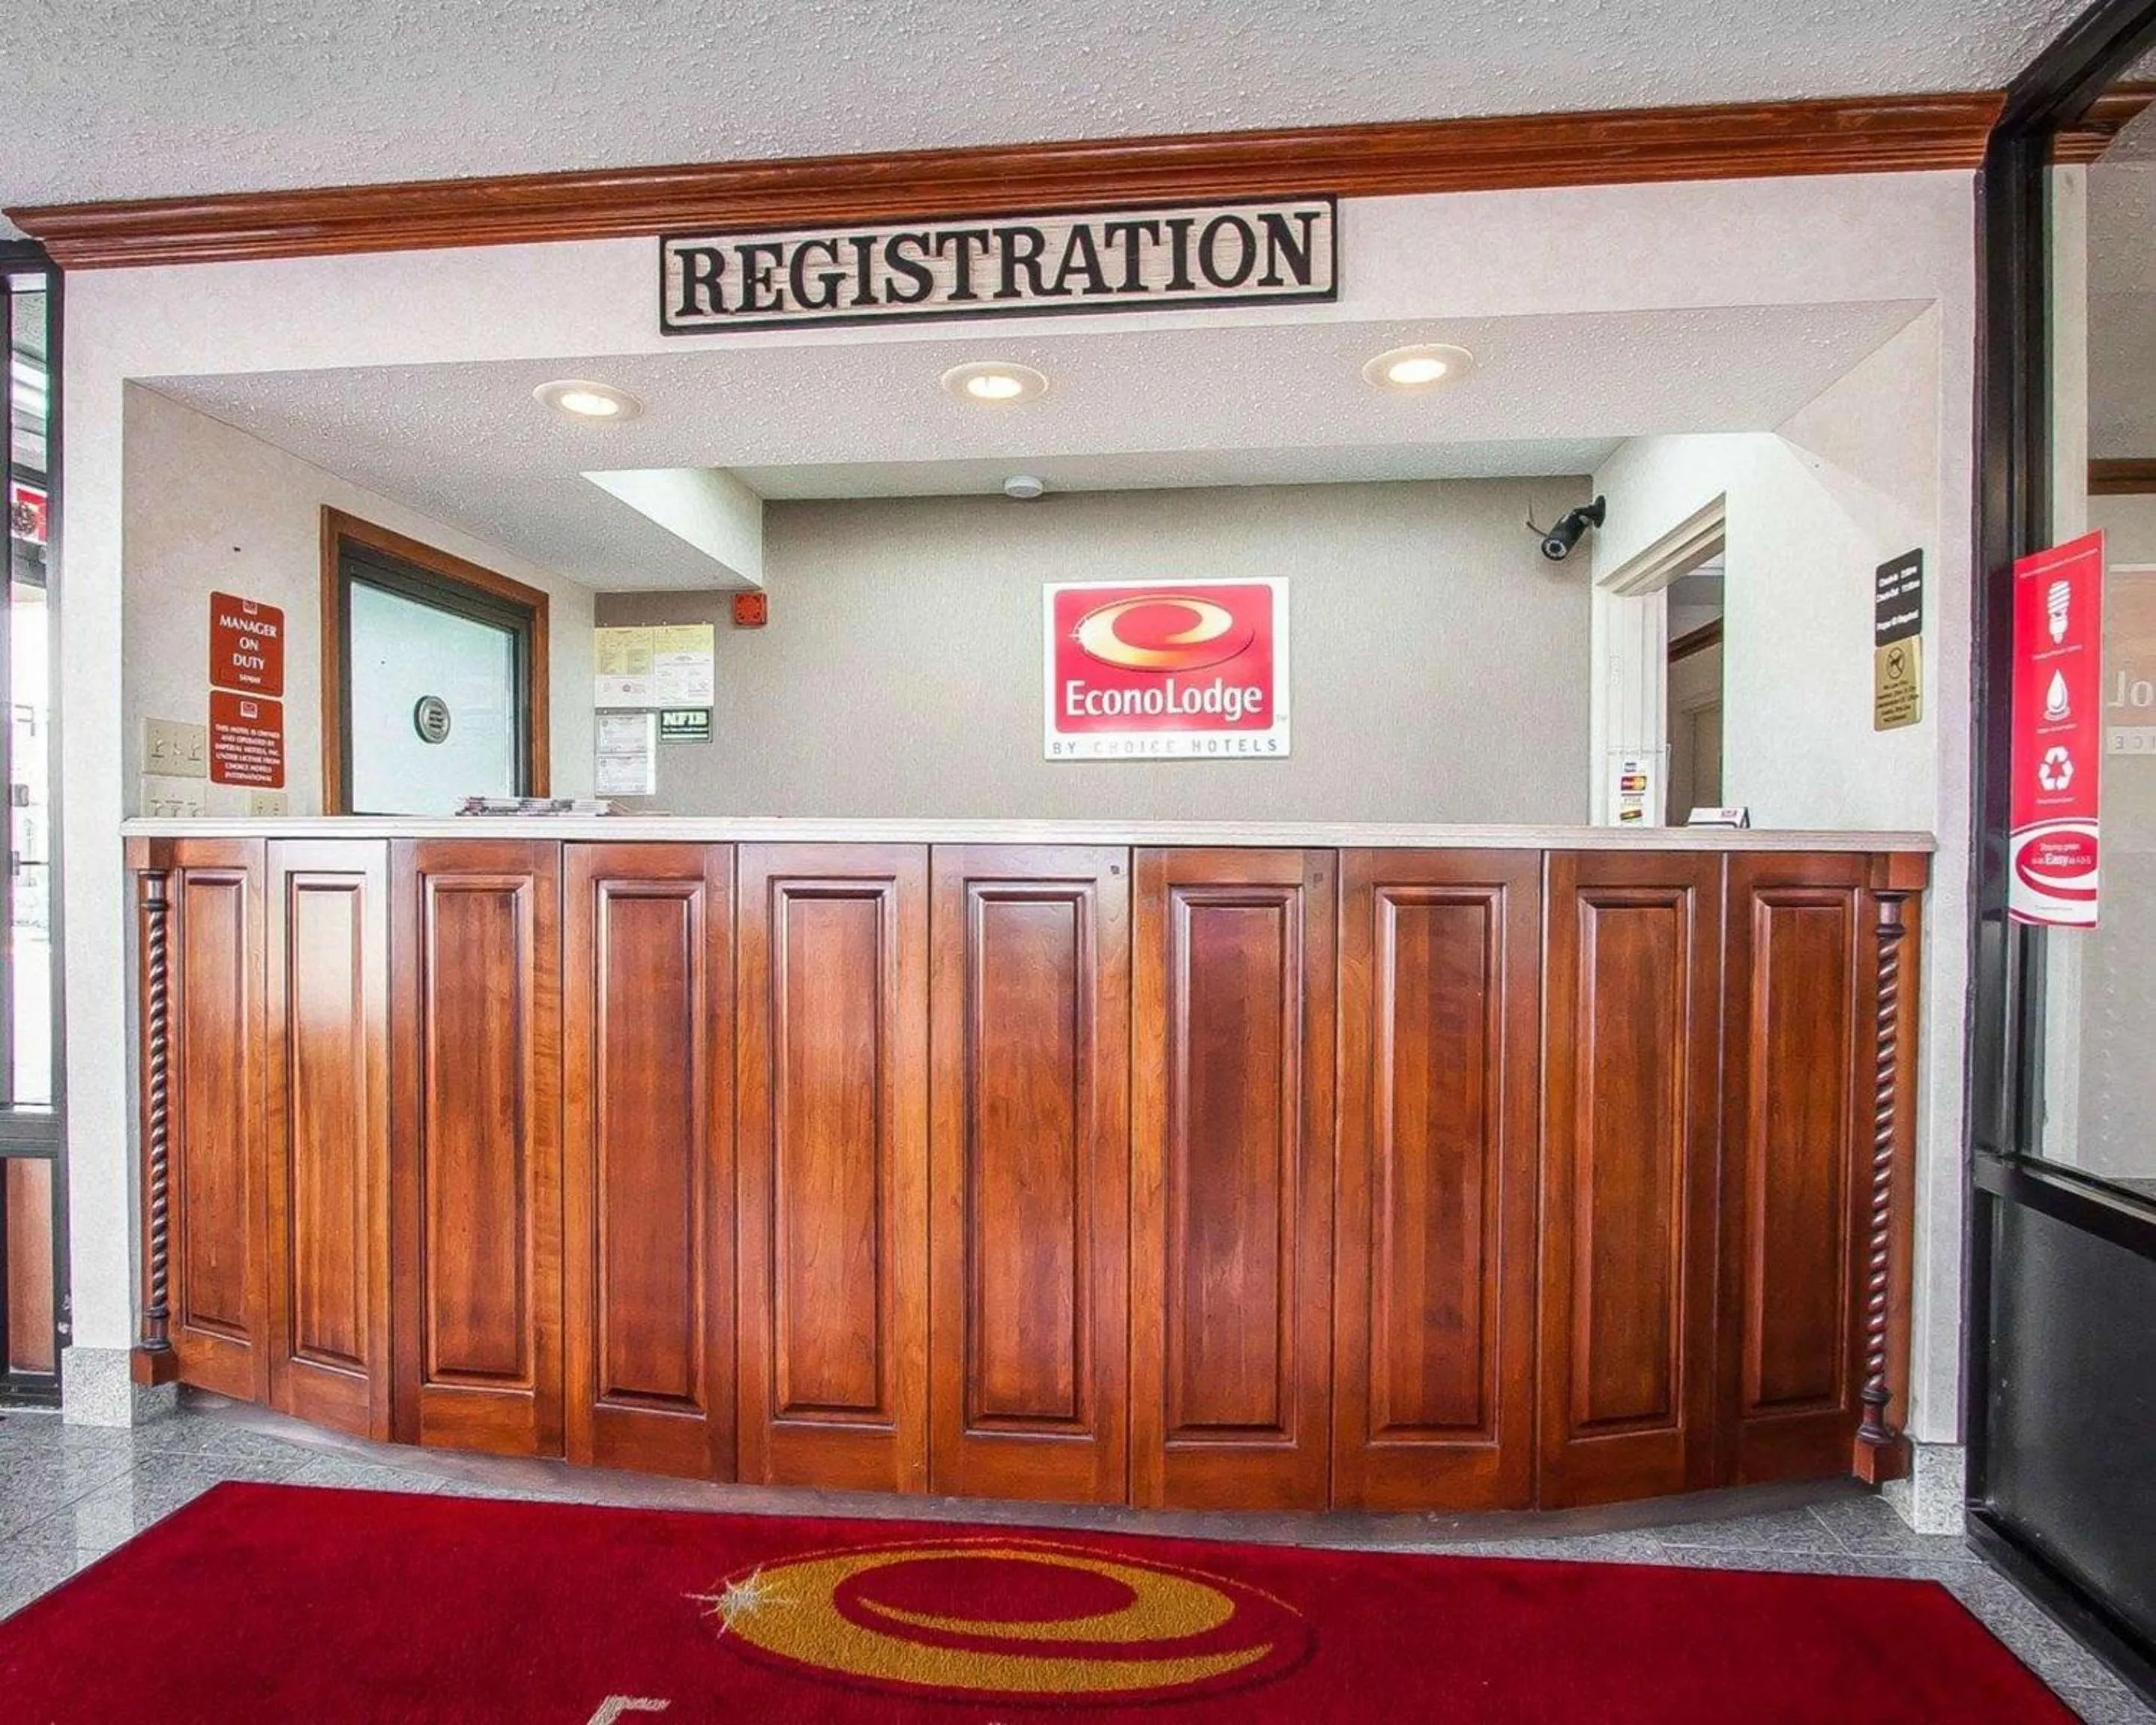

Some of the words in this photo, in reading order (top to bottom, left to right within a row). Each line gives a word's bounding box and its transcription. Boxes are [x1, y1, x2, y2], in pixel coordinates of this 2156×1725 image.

[674, 211, 1321, 317] REGISTRATION
[219, 614, 277, 639] MANAGER
[240, 636, 260, 651] ON
[233, 652, 265, 670] DUTY
[1065, 677, 1264, 722] EconoLodge
[1052, 741, 1077, 755] BY
[1094, 740, 1175, 753] CHOICE
[1192, 738, 1278, 753] HOTELS
